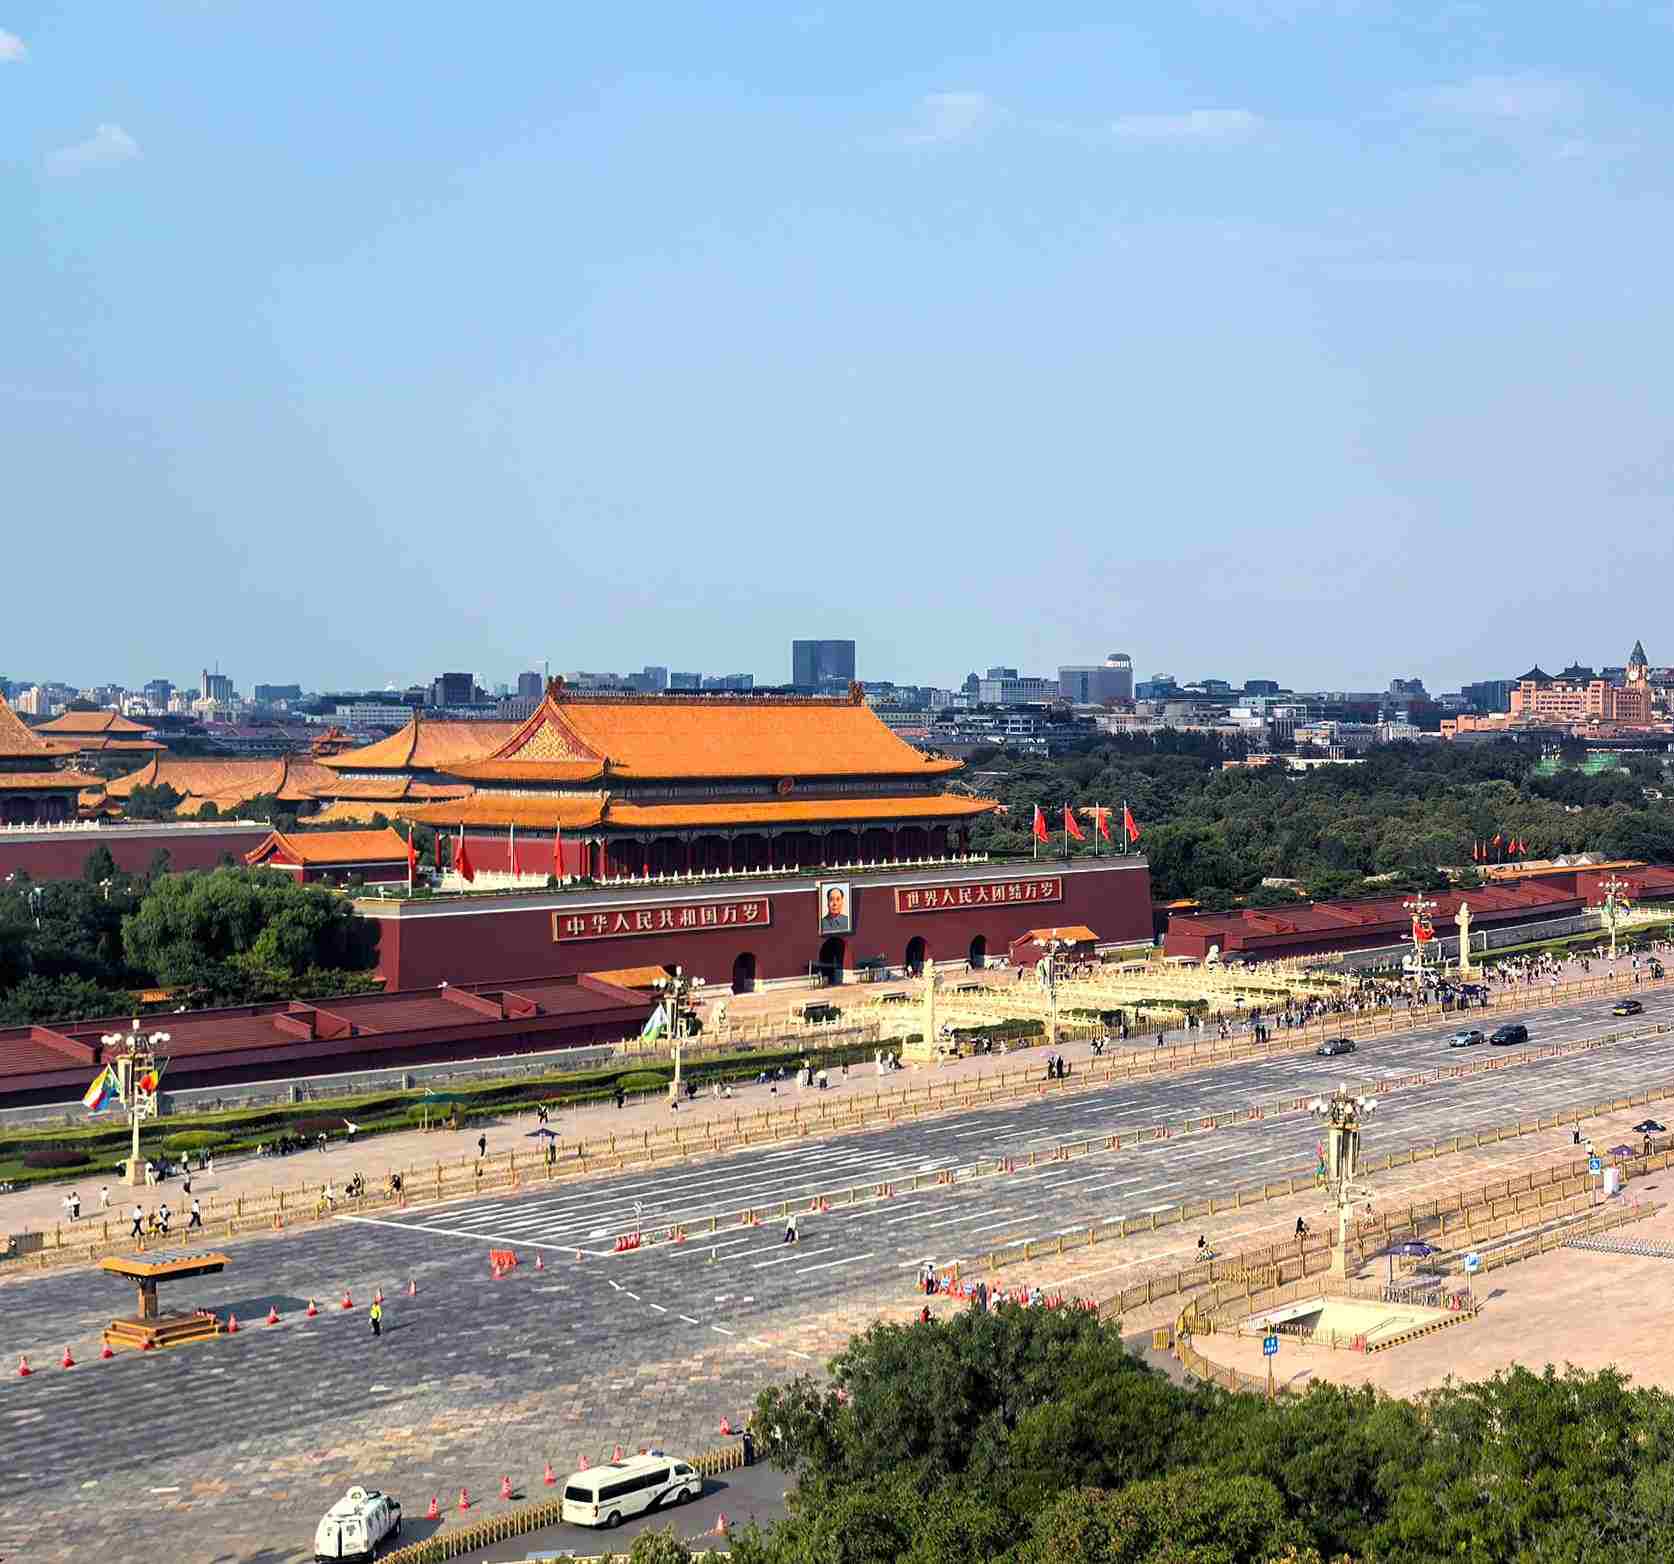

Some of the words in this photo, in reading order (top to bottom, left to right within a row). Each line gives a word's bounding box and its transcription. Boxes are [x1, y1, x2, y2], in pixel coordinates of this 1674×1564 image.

[906, 882, 1053, 908] 世界人民大团结万岁
[567, 903, 760, 935] 中华人民共和国万岁
